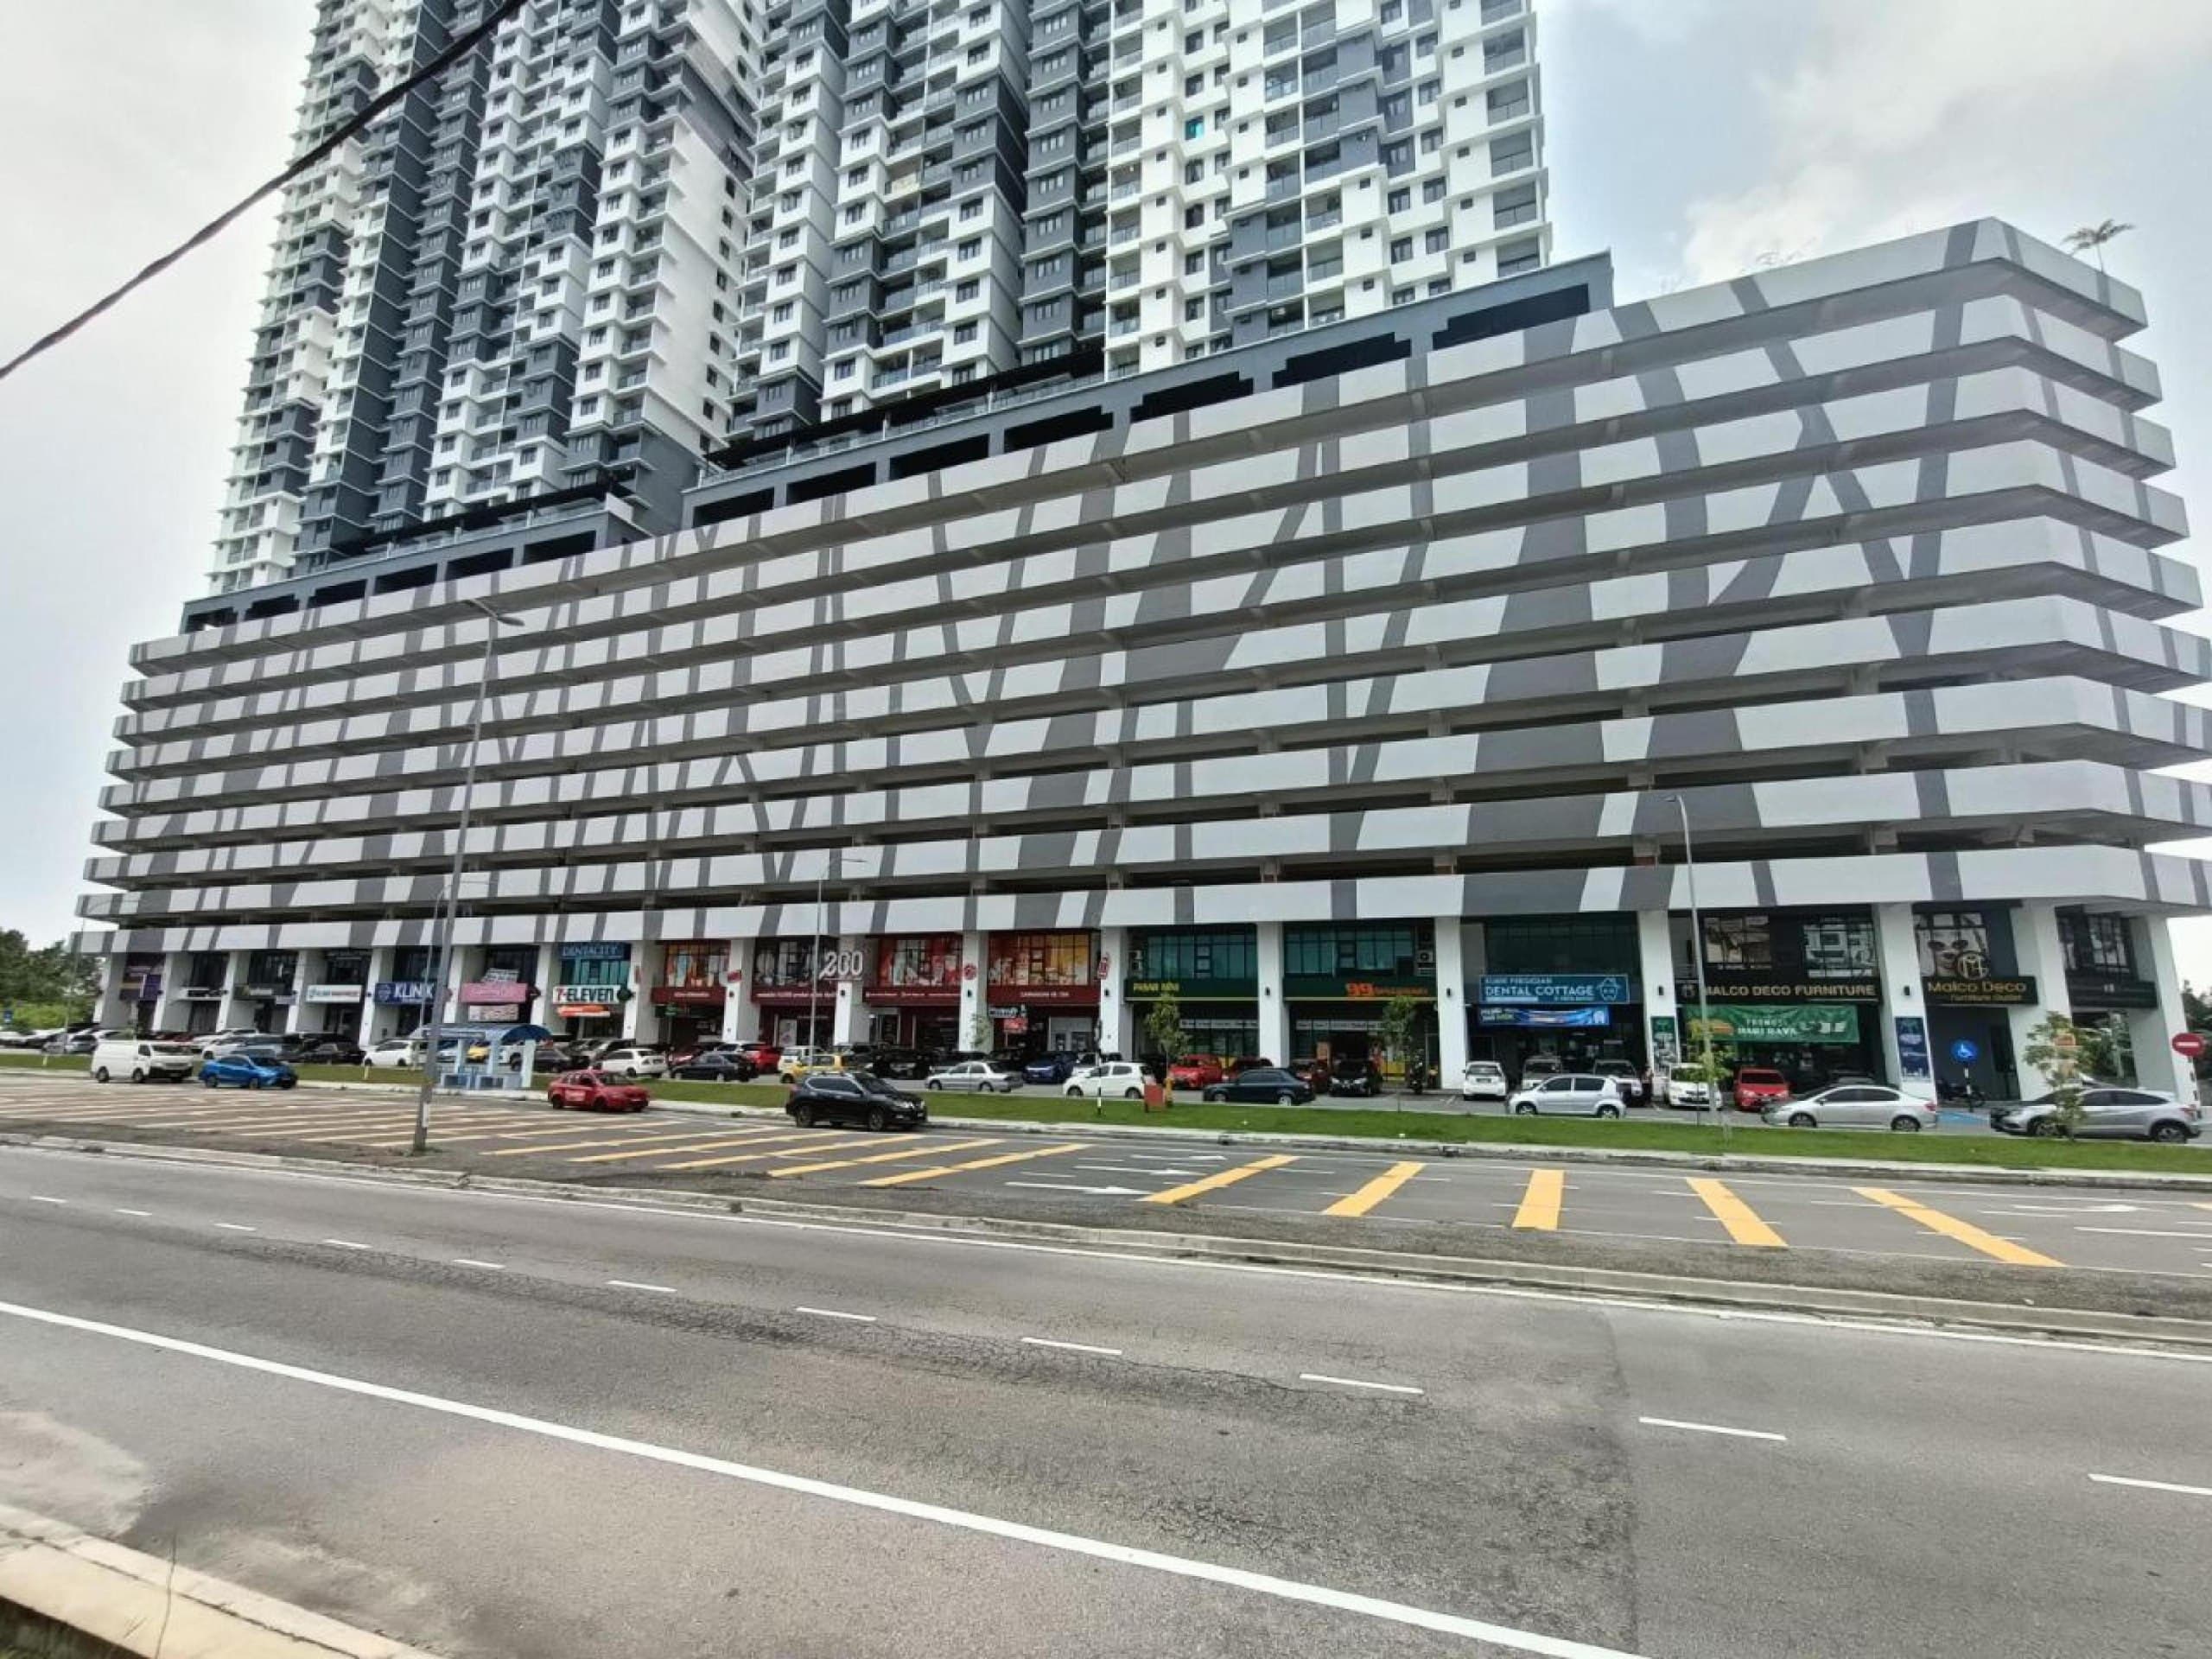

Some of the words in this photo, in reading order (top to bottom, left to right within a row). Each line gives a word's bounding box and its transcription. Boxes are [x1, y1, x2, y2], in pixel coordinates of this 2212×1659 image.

[1485, 986, 1530, 996] DENTAL
[1535, 986, 1595, 996] COTTAGE
[1752, 986, 1791, 996] DECO
[1795, 985, 1875, 996] FURNITURE
[1982, 982, 2027, 993] Deco
